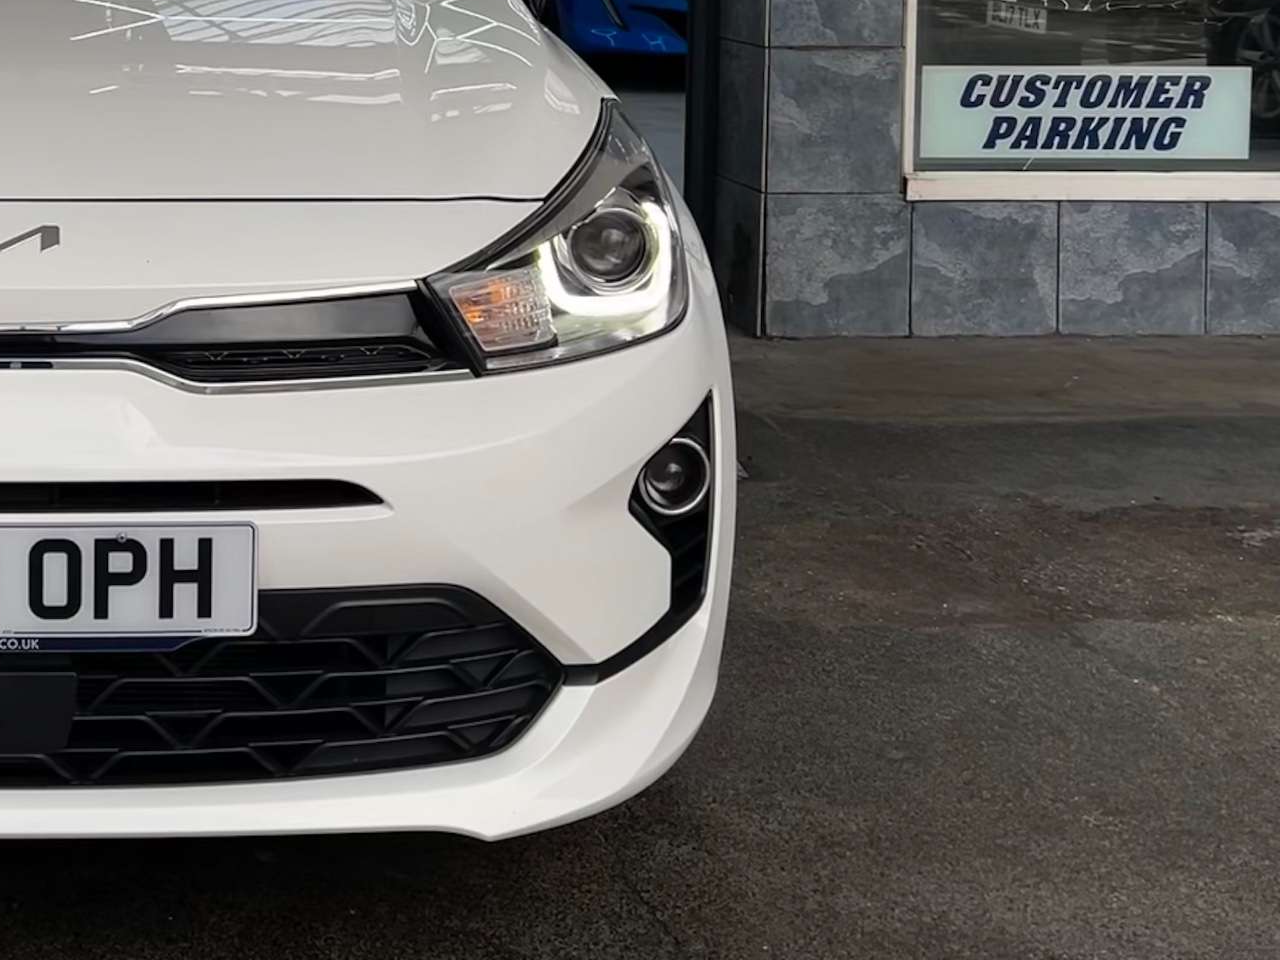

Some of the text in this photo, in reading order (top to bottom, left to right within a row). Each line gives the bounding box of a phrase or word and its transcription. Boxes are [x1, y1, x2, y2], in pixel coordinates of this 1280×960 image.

[960, 74, 1212, 109] CUSTOMER
[982, 116, 1187, 151] PARKING
[28, 536, 214, 621] OPH
